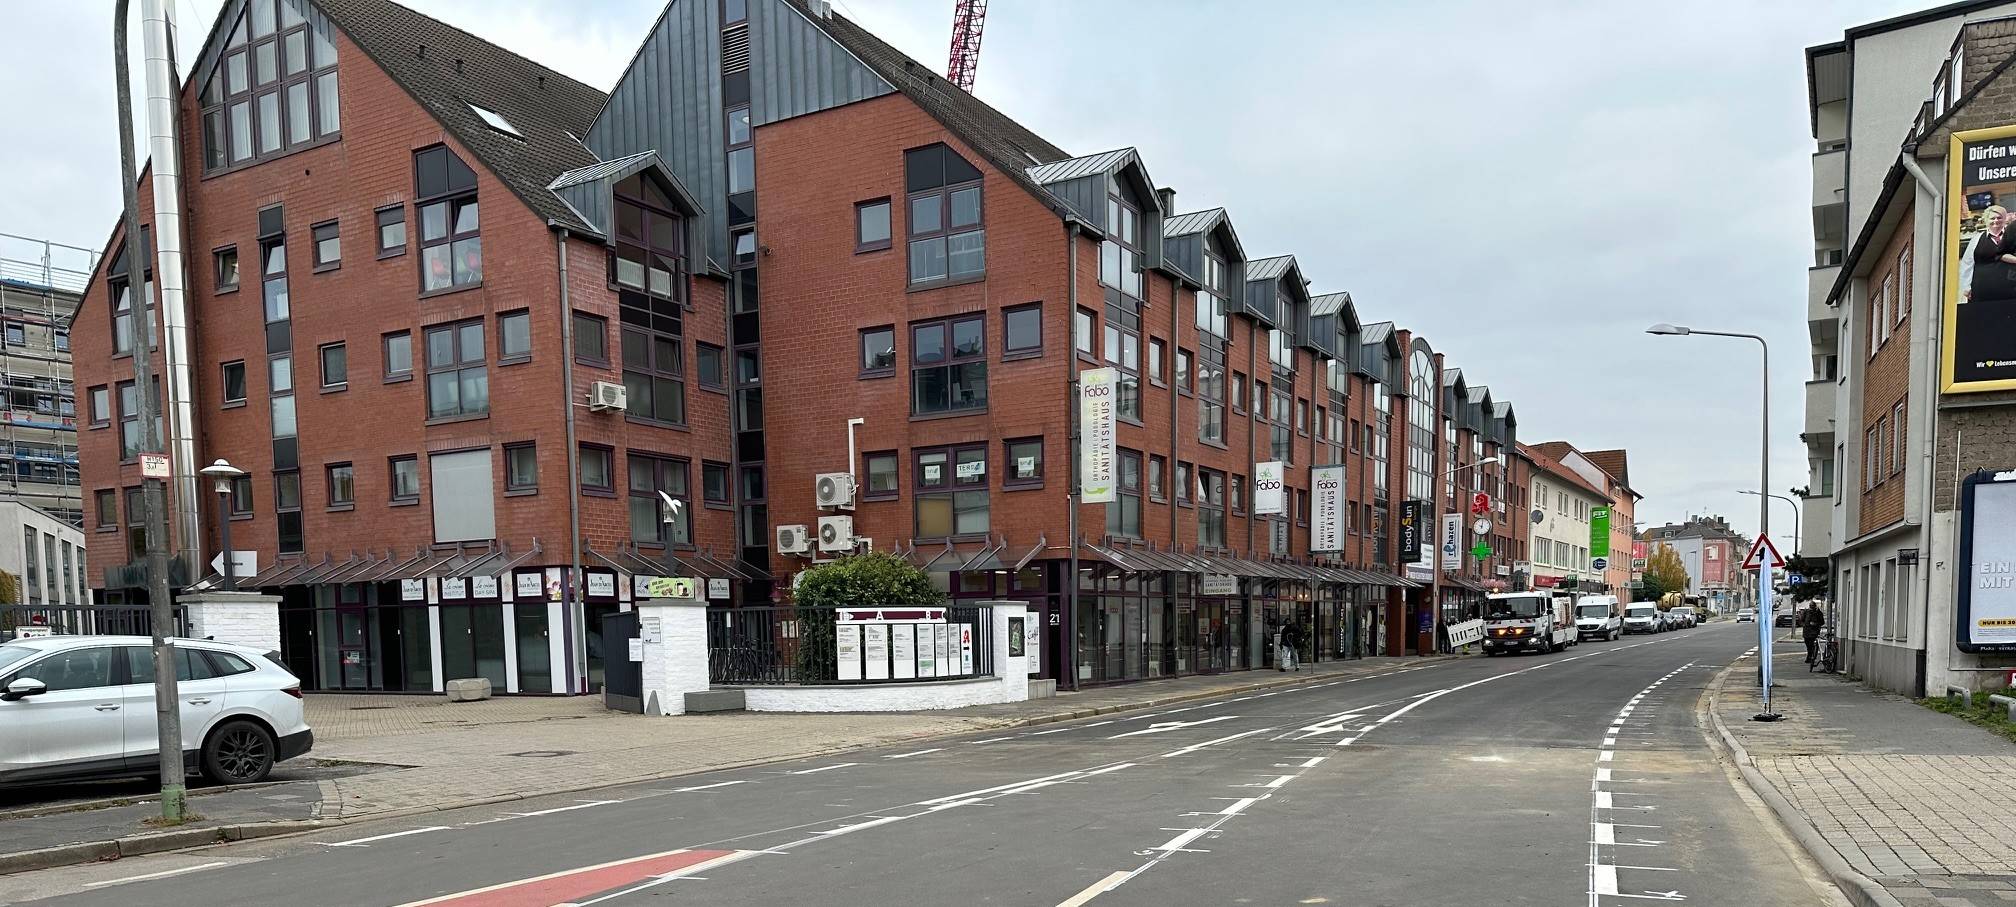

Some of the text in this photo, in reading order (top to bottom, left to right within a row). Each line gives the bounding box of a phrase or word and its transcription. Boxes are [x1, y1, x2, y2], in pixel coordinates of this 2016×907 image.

[1969, 144, 2006, 161] Dürfen
[1978, 165, 2016, 181] Unsere
[1100, 401, 1110, 481] SANITÄTSHAUS
[1326, 490, 1335, 549] SANITÄTSHAUS
[1402, 505, 1414, 552] bodySun
[1980, 561, 2011, 574] EIN
[1979, 576, 2014, 589] MIT
[875, 610, 931, 620] A B
[1050, 613, 1060, 623] 21
